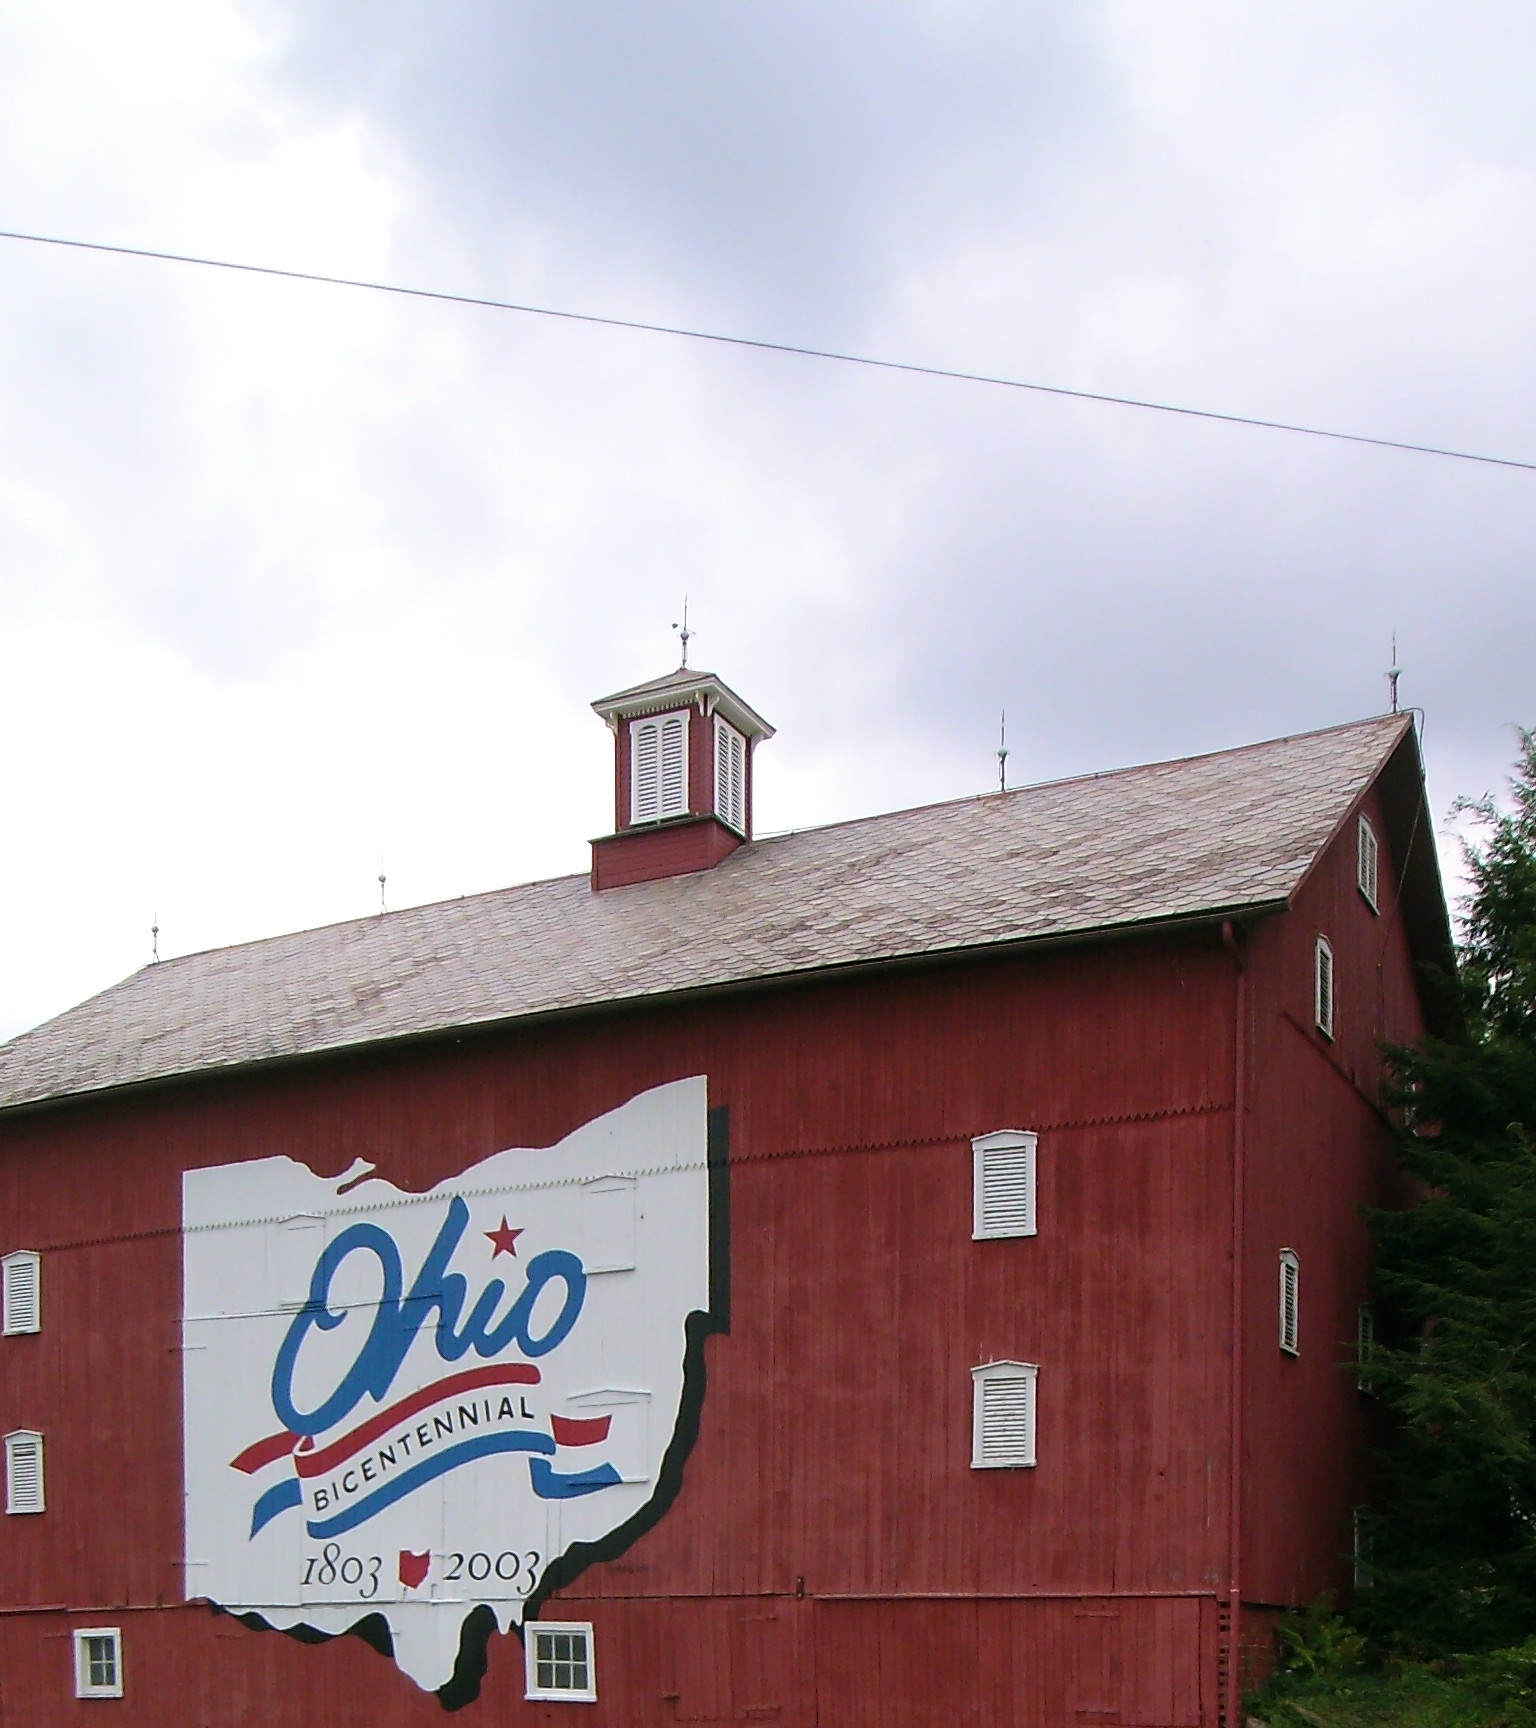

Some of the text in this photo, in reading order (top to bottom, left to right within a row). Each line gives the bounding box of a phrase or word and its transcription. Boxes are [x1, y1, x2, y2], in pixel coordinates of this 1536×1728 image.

[270, 1195, 587, 1436] Ohio
[313, 1397, 535, 1511] BICENTENNIAL
[300, 1543, 541, 1598] 1803 2003
